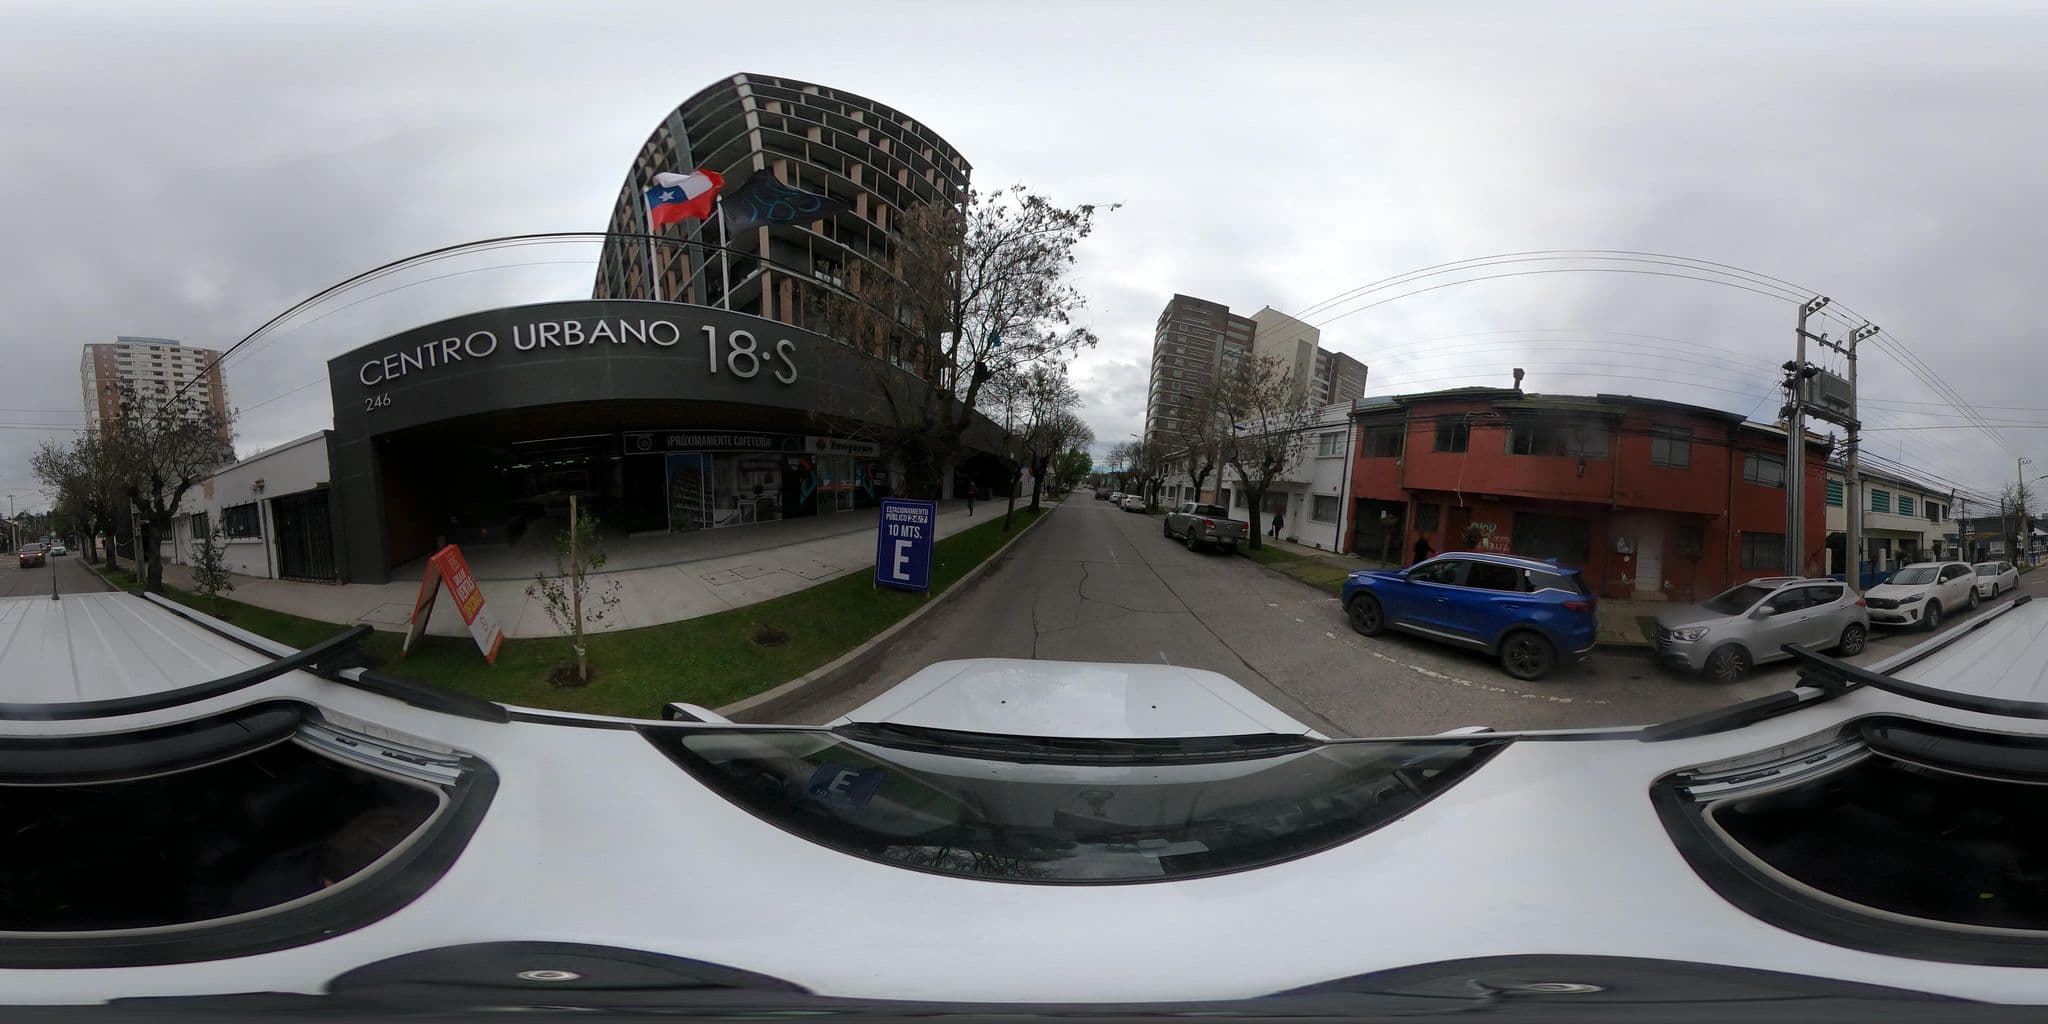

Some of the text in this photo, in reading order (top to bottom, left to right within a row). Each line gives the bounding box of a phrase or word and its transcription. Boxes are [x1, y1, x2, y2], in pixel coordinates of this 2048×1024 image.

[359, 319, 680, 386] CENTRO URBANO
[365, 392, 392, 413] 246
[886, 506, 928, 515] ESTACIONAMIENTO
[888, 523, 923, 539] 10 MTS.
[893, 539, 913, 581] E
